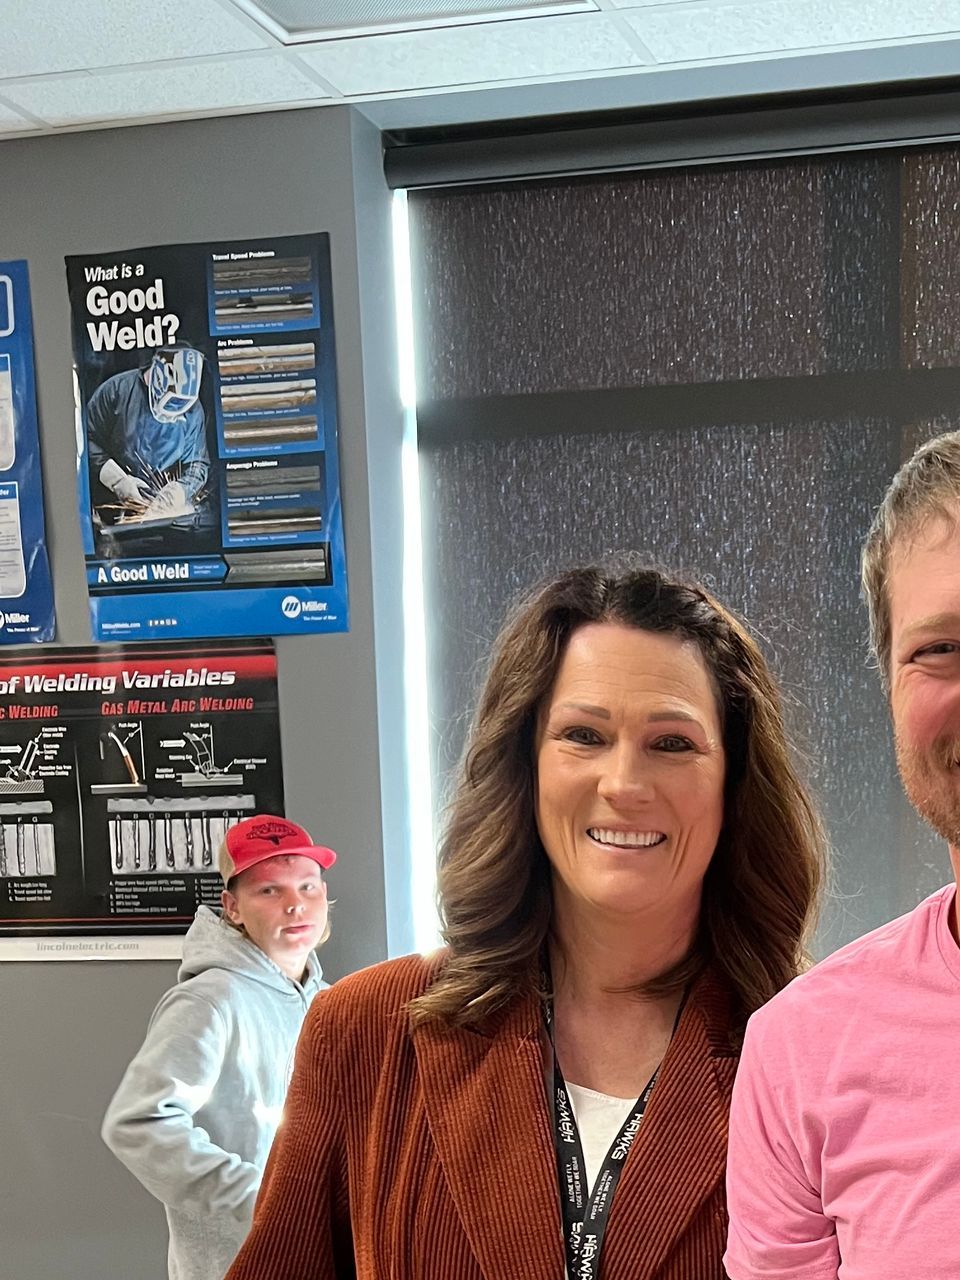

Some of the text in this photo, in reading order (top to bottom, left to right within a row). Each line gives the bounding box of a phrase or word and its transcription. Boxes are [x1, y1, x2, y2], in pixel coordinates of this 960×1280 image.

[84, 264, 144, 282] What is a
[86, 279, 164, 316] Good
[86, 314, 180, 352] Weld?
[98, 567, 108, 583] A
[110, 565, 148, 582] Good
[151, 563, 189, 580] Weld
[302, 601, 327, 611] Miller
[5, 613, 30, 623] Miller
[24, 673, 116, 694] Welding
[122, 668, 236, 689] Variables
[9, 705, 58, 719] WELDING
[101, 698, 253, 716] GAS METAL ARC WELDING
[36, 942, 139, 951] lincolnelectric.com
[556, 1088, 575, 1143] HAWKS
[611, 1113, 644, 1160] HAWKS
